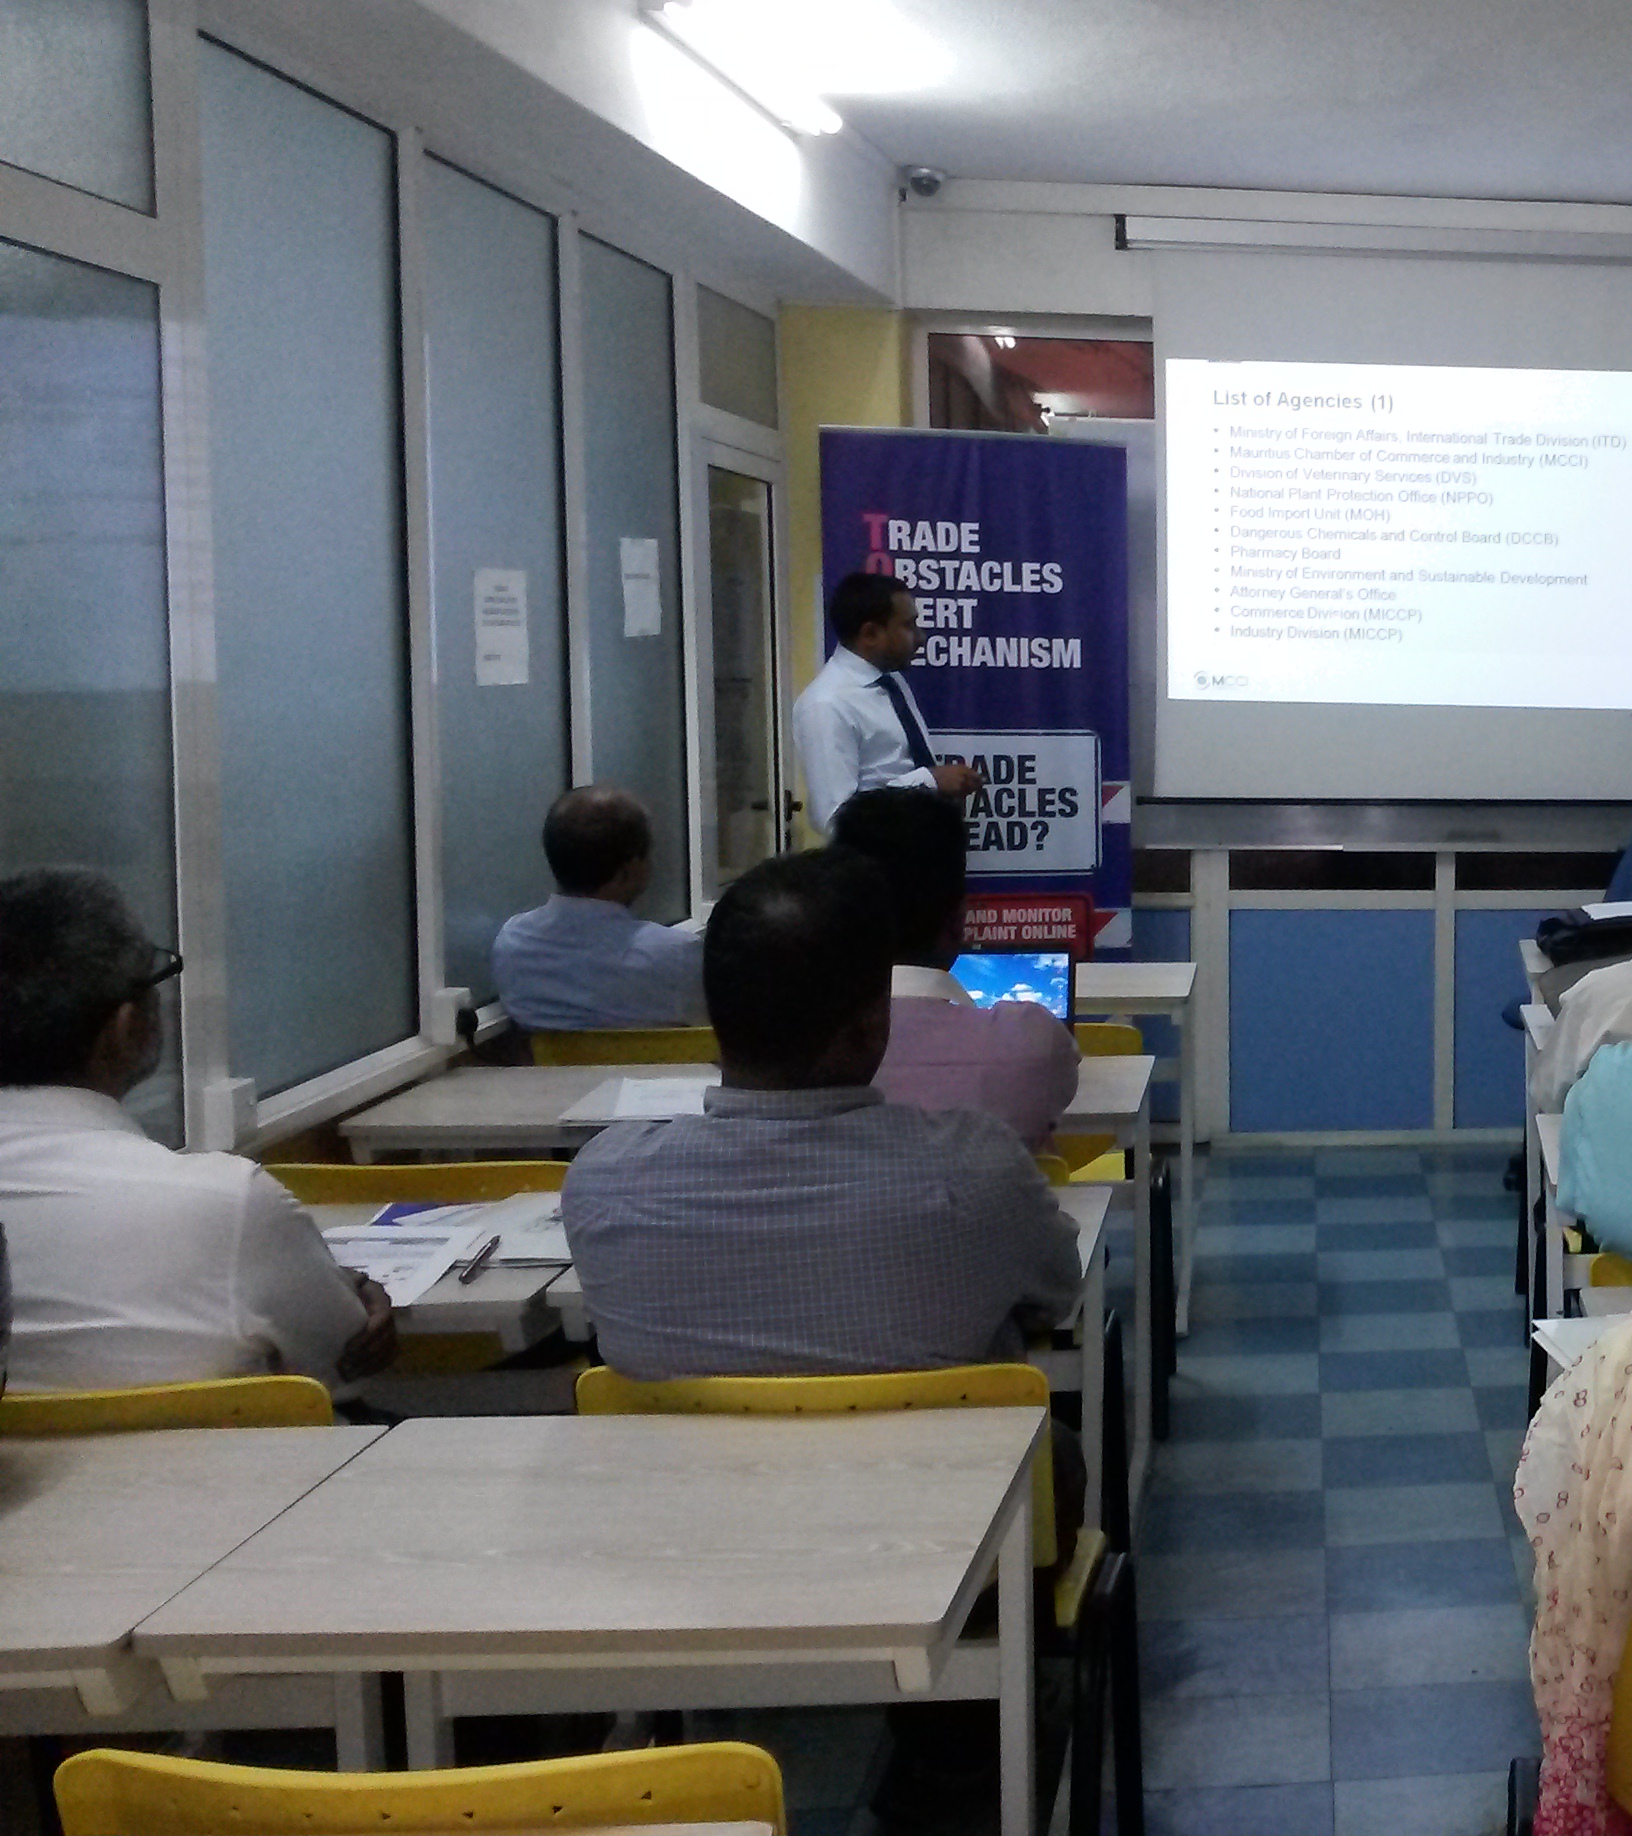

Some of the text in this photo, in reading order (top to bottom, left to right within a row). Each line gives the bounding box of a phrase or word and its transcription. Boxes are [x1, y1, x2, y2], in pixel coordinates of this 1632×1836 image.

[1213, 390, 1393, 413] List of Agencies (1)
[1230, 426, 1282, 442] Ministry
[1285, 427, 1298, 440] of
[1302, 428, 1352, 444] Foreign
[1406, 430, 1488, 446] International
[1493, 432, 1532, 446] Trade
[1536, 433, 1588, 448] Division
[1591, 434, 1627, 450] (ITD)
[1294, 448, 1354, 462] Chamber
[1359, 449, 1372, 462] of
[1376, 449, 1450, 464] Commerce
[1453, 451, 1477, 464] and
[1482, 453, 1534, 469] Industry
[1539, 454, 1589, 470] (MCCI)
[1230, 466, 1283, 480] Division
[1286, 467, 1298, 480] of
[1374, 469, 1432, 484] Services
[1436, 471, 1477, 486] (DVS)
[1230, 486, 1493, 506] National Plant Protection Office (NPPO)
[1230, 506, 1391, 523] Food Import Unit (MOH)
[863, 513, 980, 553] TRADE
[1230, 525, 1559, 547] Dangerous Chemicals and Control Board (DCCB)
[1230, 545, 1341, 561] Pharmacy Board
[1230, 565, 1588, 587] Ministry of Environment and Sustainable Development
[1230, 585, 1285, 601] Attorney
[1357, 588, 1396, 601] Office
[914, 597, 978, 629] ERT
[1230, 606, 1422, 623] Commerce Division (MICCP)
[1230, 625, 1402, 643] Industry Division (MICCP)
[910, 635, 1081, 668] CHANISM
[964, 787, 1079, 819] ACLES
[966, 820, 1050, 851] EAD?
[965, 908, 1072, 924] AND MONITOR
[963, 924, 1077, 941] PLAINT ONLINE
